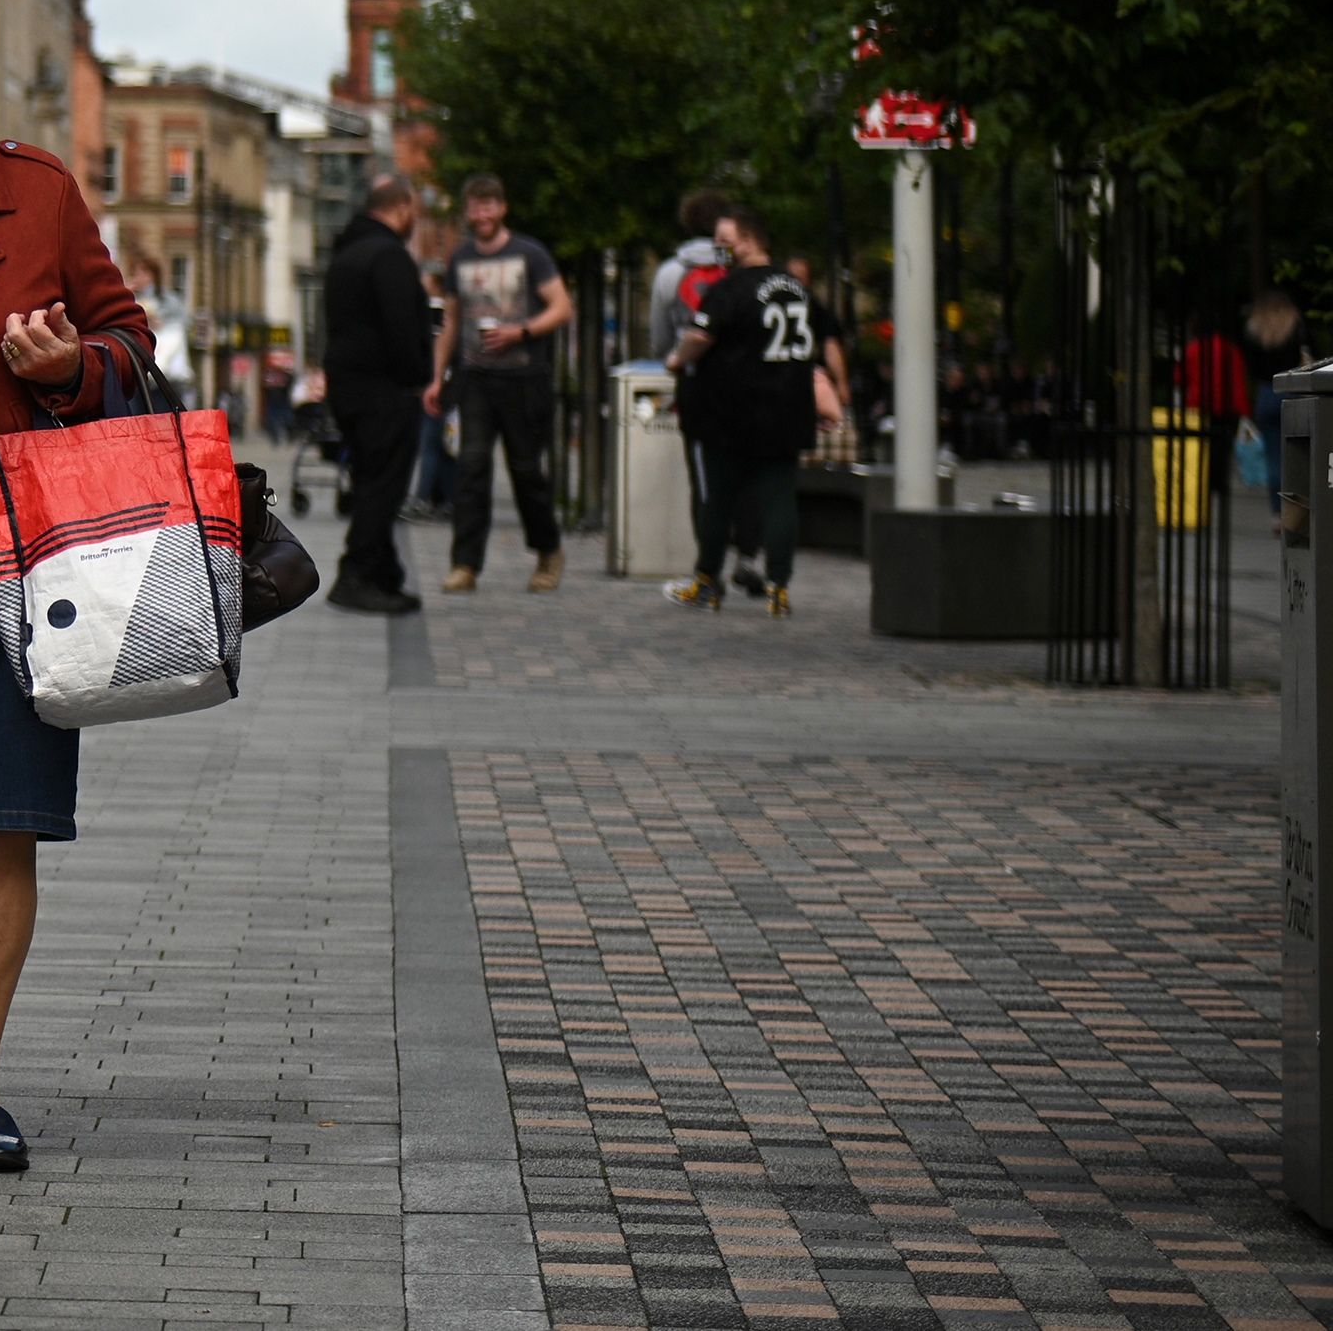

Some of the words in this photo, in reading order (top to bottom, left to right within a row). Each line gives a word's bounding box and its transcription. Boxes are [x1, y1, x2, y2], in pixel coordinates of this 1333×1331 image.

[763, 301, 814, 362] 23
[80, 552, 108, 562] Brittany
[109, 545, 134, 555] Ferries
